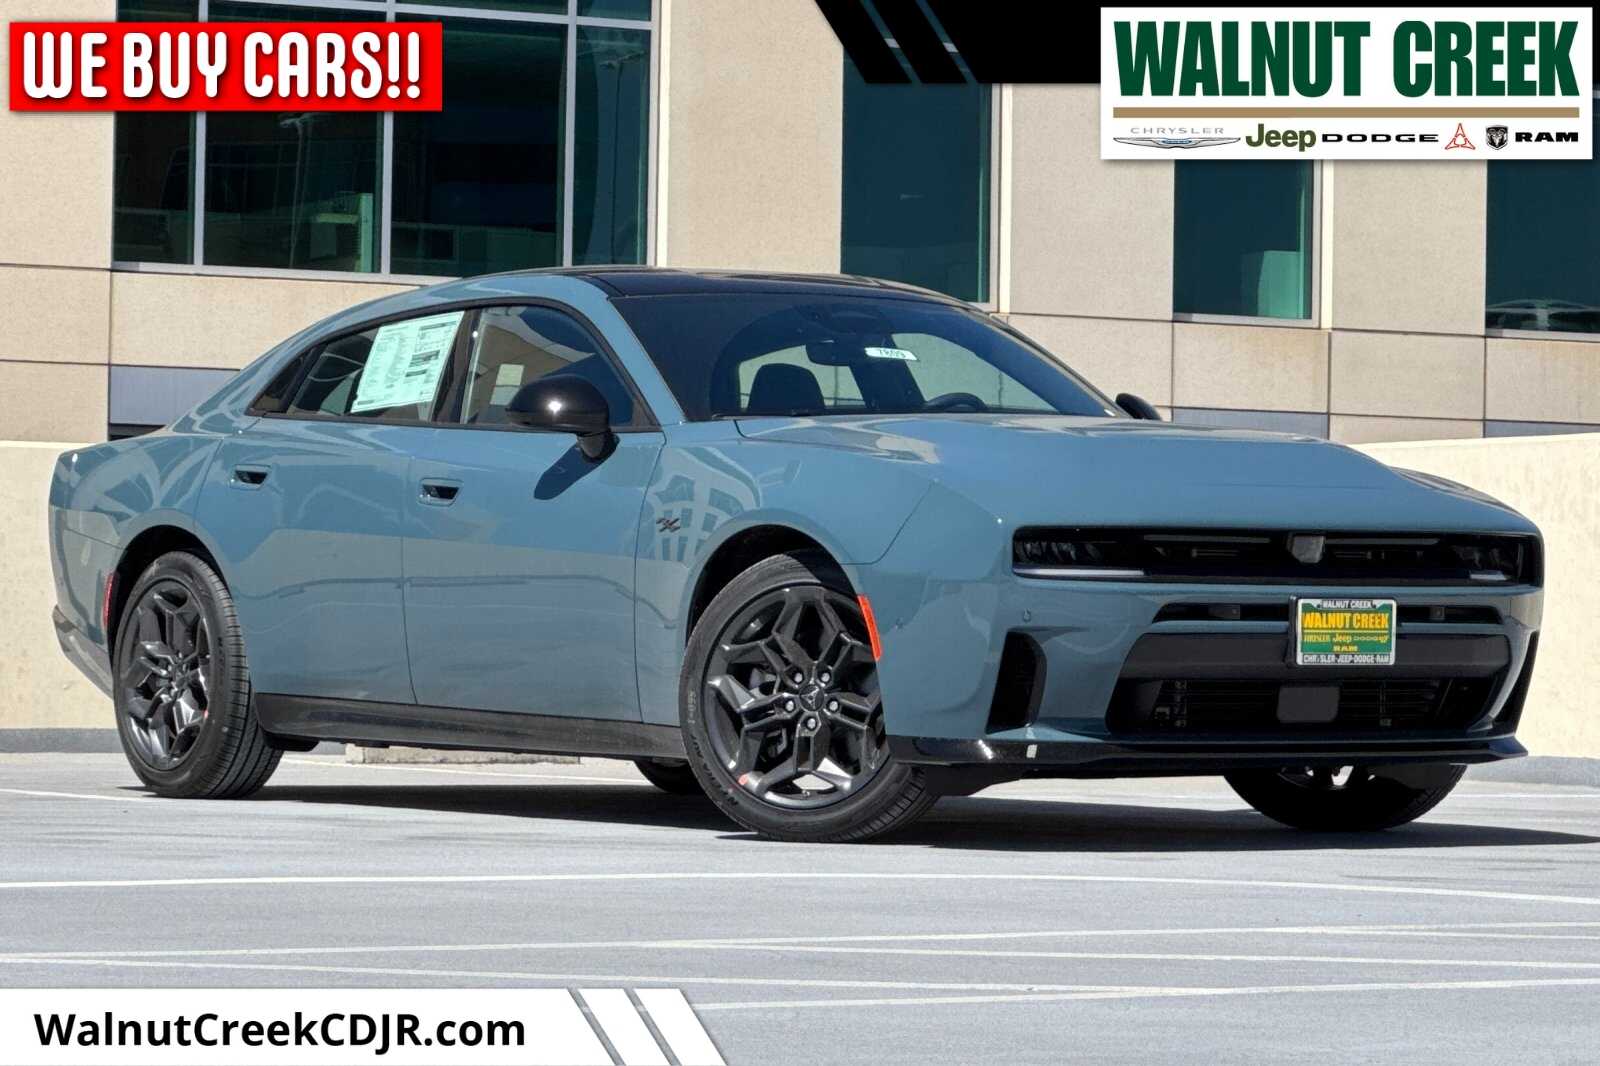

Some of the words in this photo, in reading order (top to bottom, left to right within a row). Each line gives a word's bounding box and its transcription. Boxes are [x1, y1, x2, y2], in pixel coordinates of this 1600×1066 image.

[1322, 600, 1349, 609] WALNUT
[1351, 600, 1373, 609] CREEK
[1303, 612, 1351, 629] WALNUT
[1353, 612, 1389, 629] CREEK
